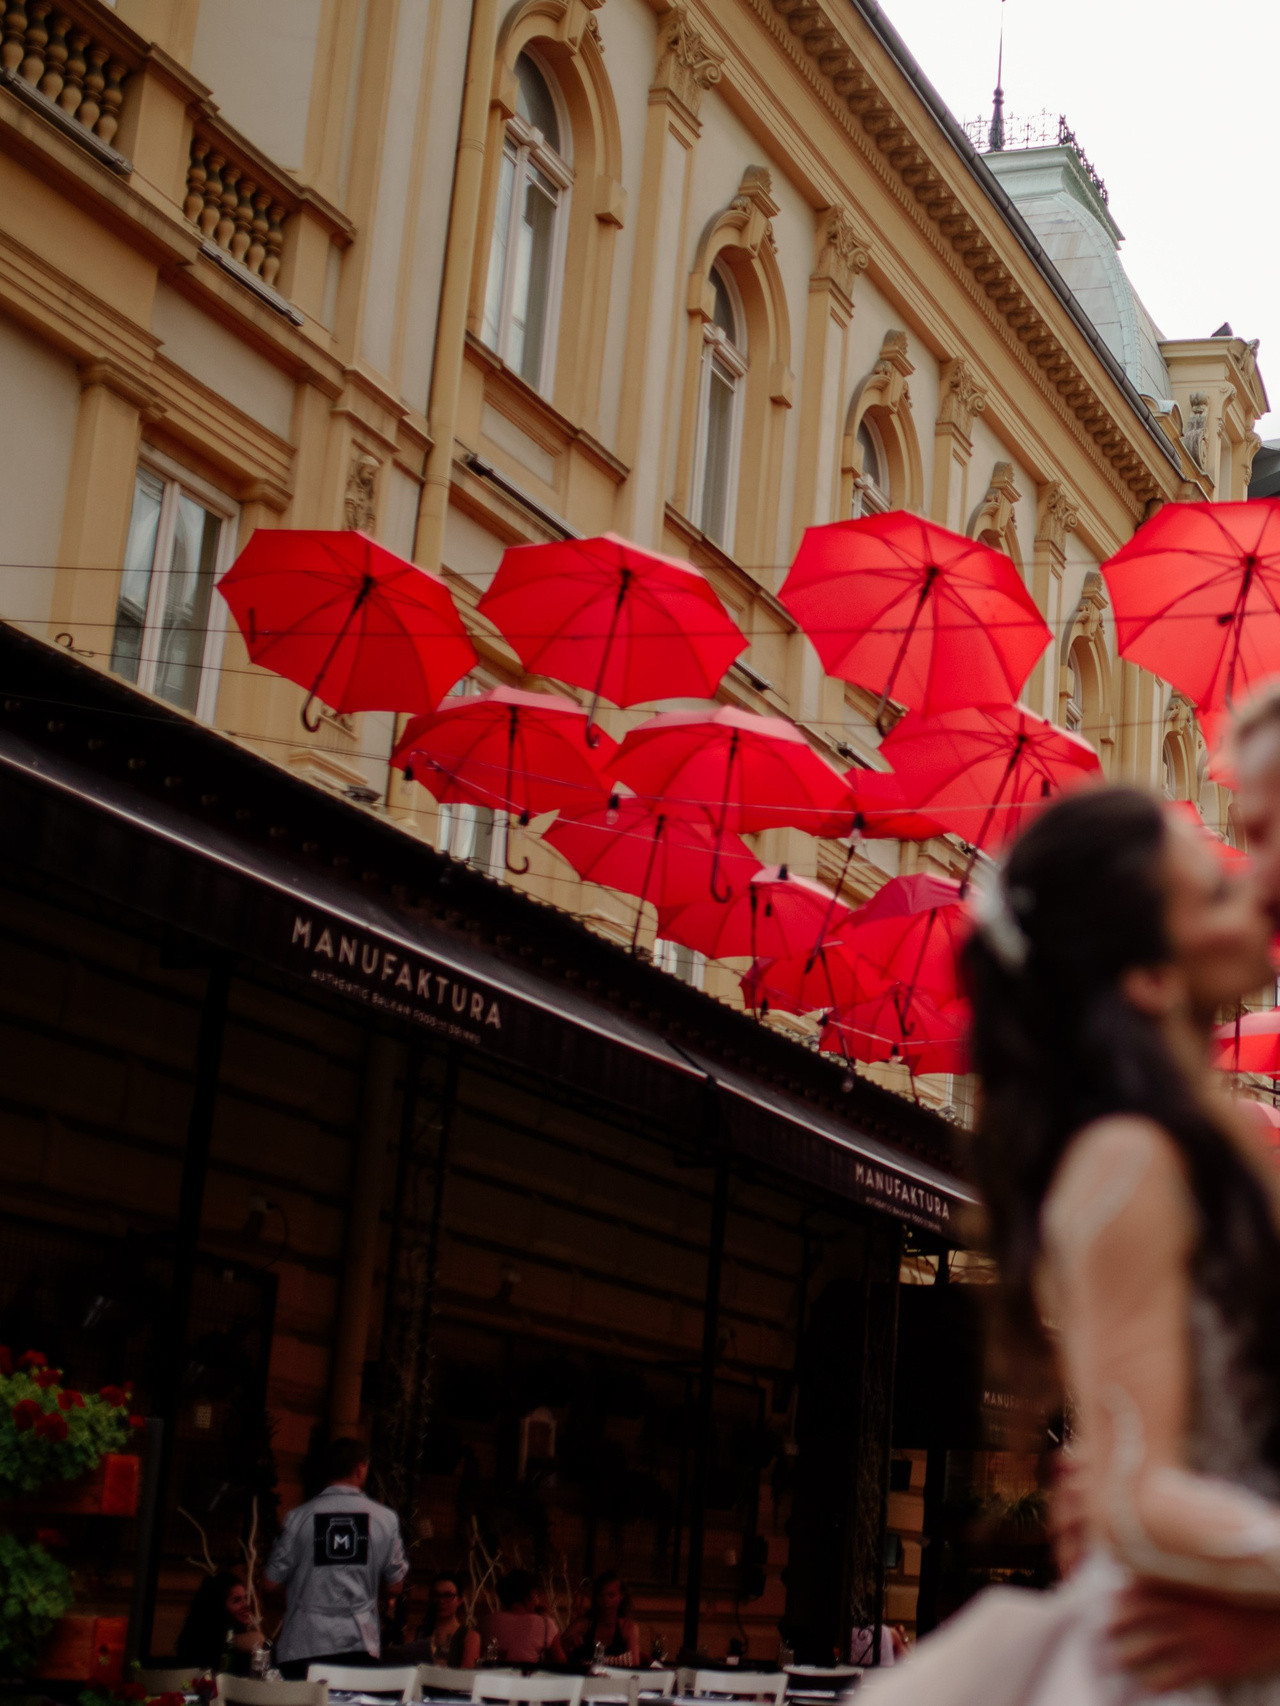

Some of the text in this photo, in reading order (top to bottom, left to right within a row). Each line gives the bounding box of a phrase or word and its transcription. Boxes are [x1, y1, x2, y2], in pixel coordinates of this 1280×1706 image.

[291, 916, 502, 1029] MANUFAKTURA
[310, 969, 370, 1000] AUTHENTIC
[855, 1163, 950, 1220] MANUFAKTURA
[333, 1533, 350, 1550] M
